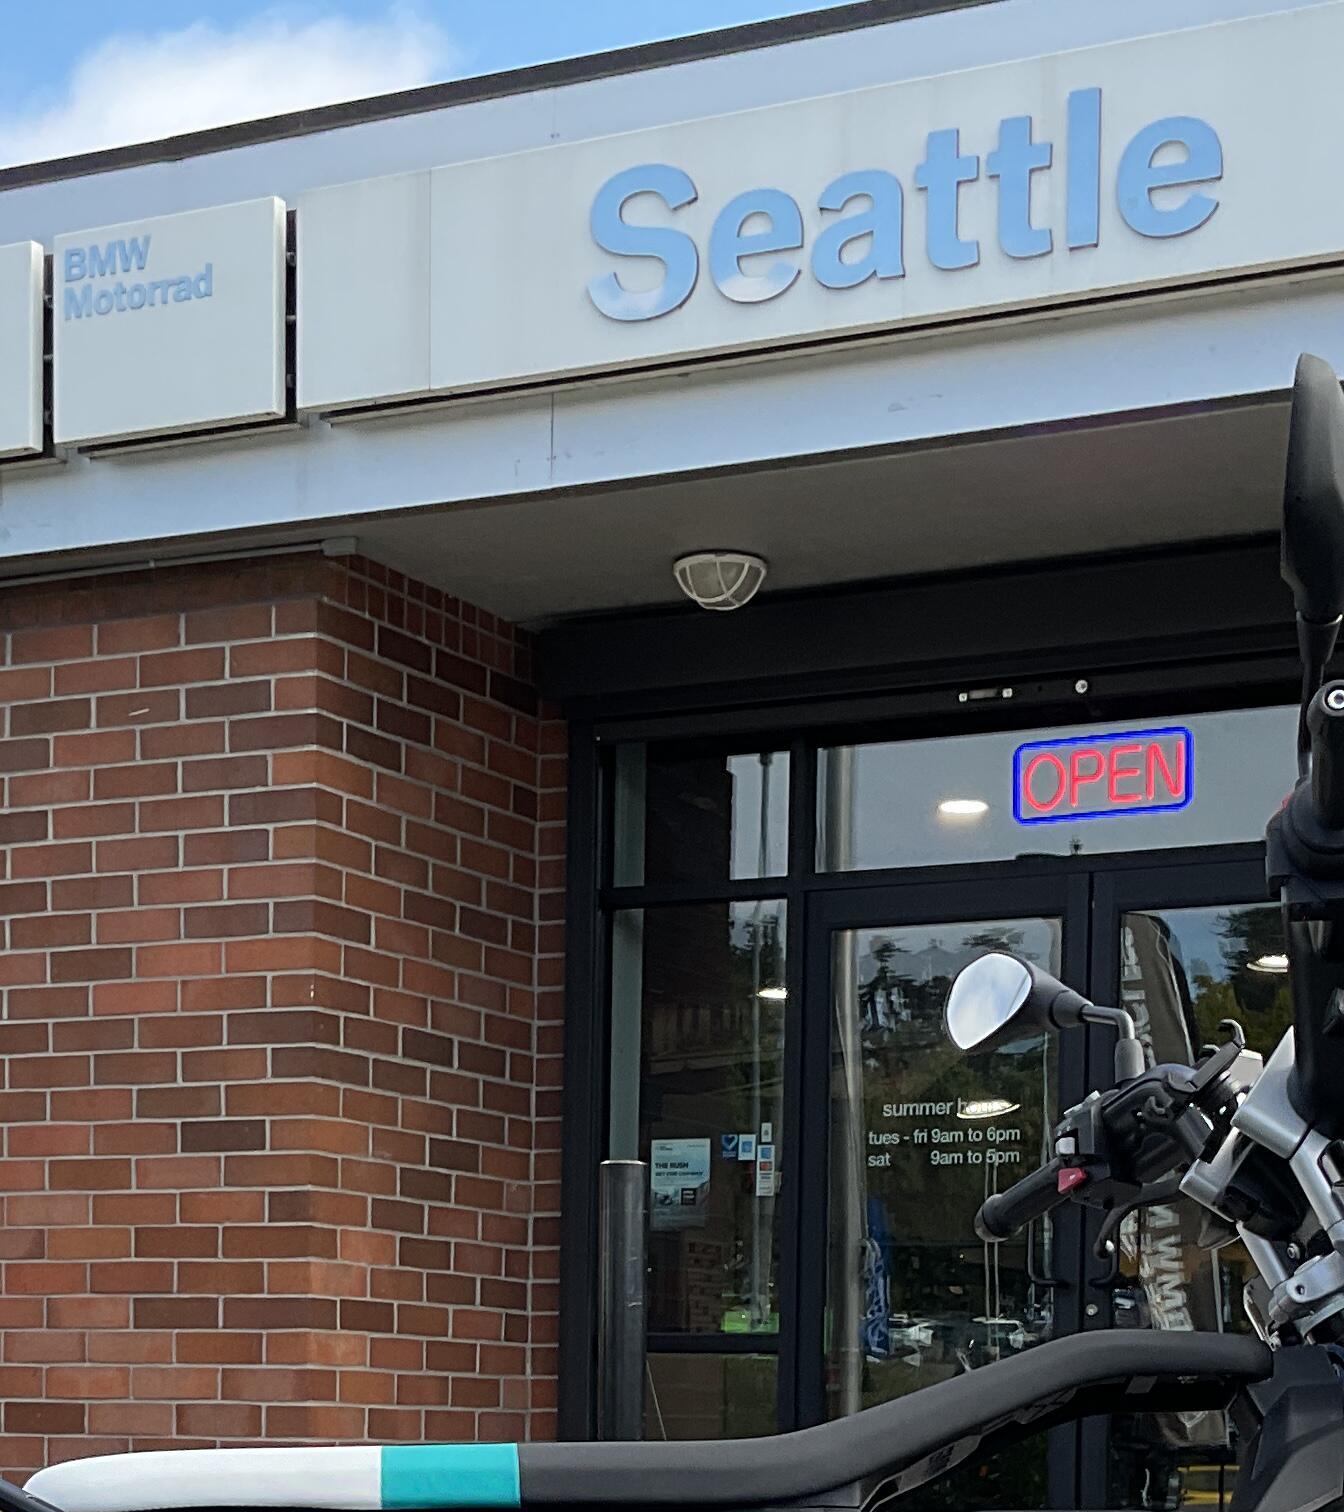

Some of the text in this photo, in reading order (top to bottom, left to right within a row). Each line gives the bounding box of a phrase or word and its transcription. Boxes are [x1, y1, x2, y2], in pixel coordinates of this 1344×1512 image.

[588, 87, 1224, 322] Seattle
[64, 234, 152, 282] BMW
[64, 263, 214, 321] Motorrad
[1023, 739, 1184, 812] OPEN
[882, 1101, 954, 1117] summer
[868, 1131, 900, 1145] tues
[913, 1128, 928, 1144] fri
[931, 1128, 964, 1144] 9am
[968, 1127, 983, 1142] to
[986, 1126, 1021, 1145] 6pm
[868, 1148, 1020, 1167] sat 9am to 5pm
